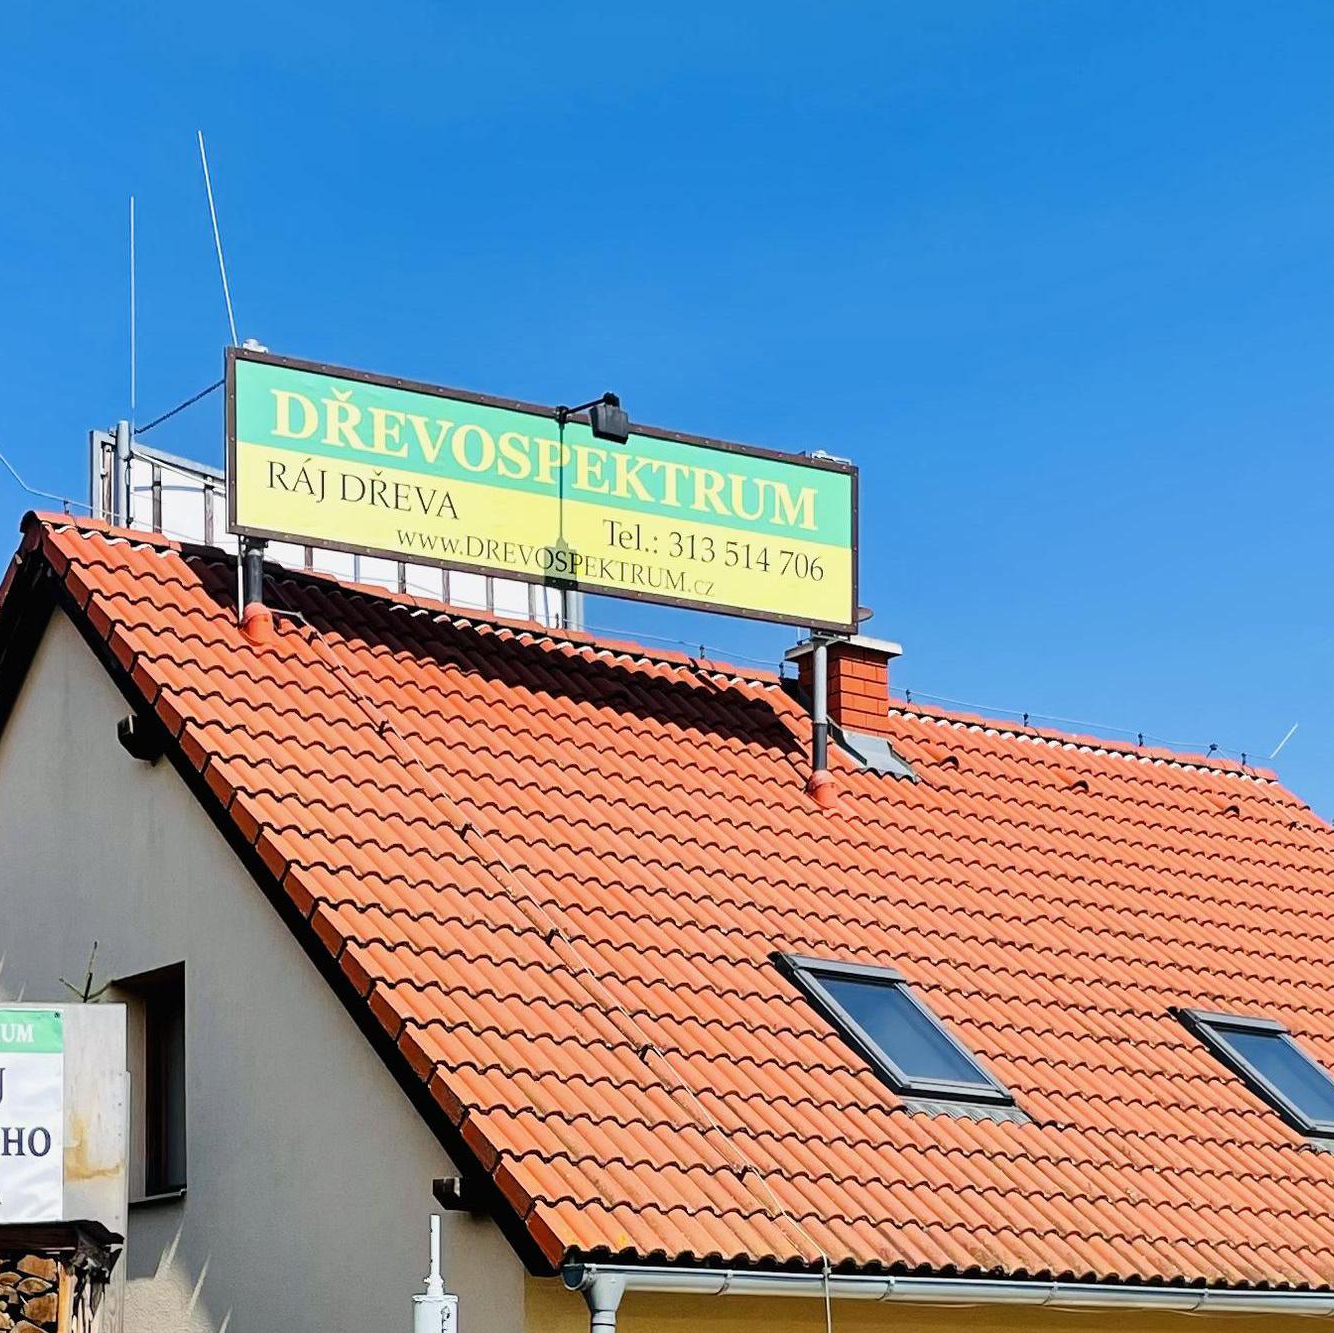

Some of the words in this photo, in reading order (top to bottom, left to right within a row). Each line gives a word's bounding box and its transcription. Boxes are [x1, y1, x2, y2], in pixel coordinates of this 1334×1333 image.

[267, 457, 328, 503] RÁJ
[339, 469, 460, 520] DŘEVA
[270, 387, 819, 531] DŘEVOSPEKTRUM
[602, 519, 659, 554] Tel.:
[668, 531, 716, 563] 313
[724, 541, 770, 572] 514
[779, 550, 824, 582] 706
